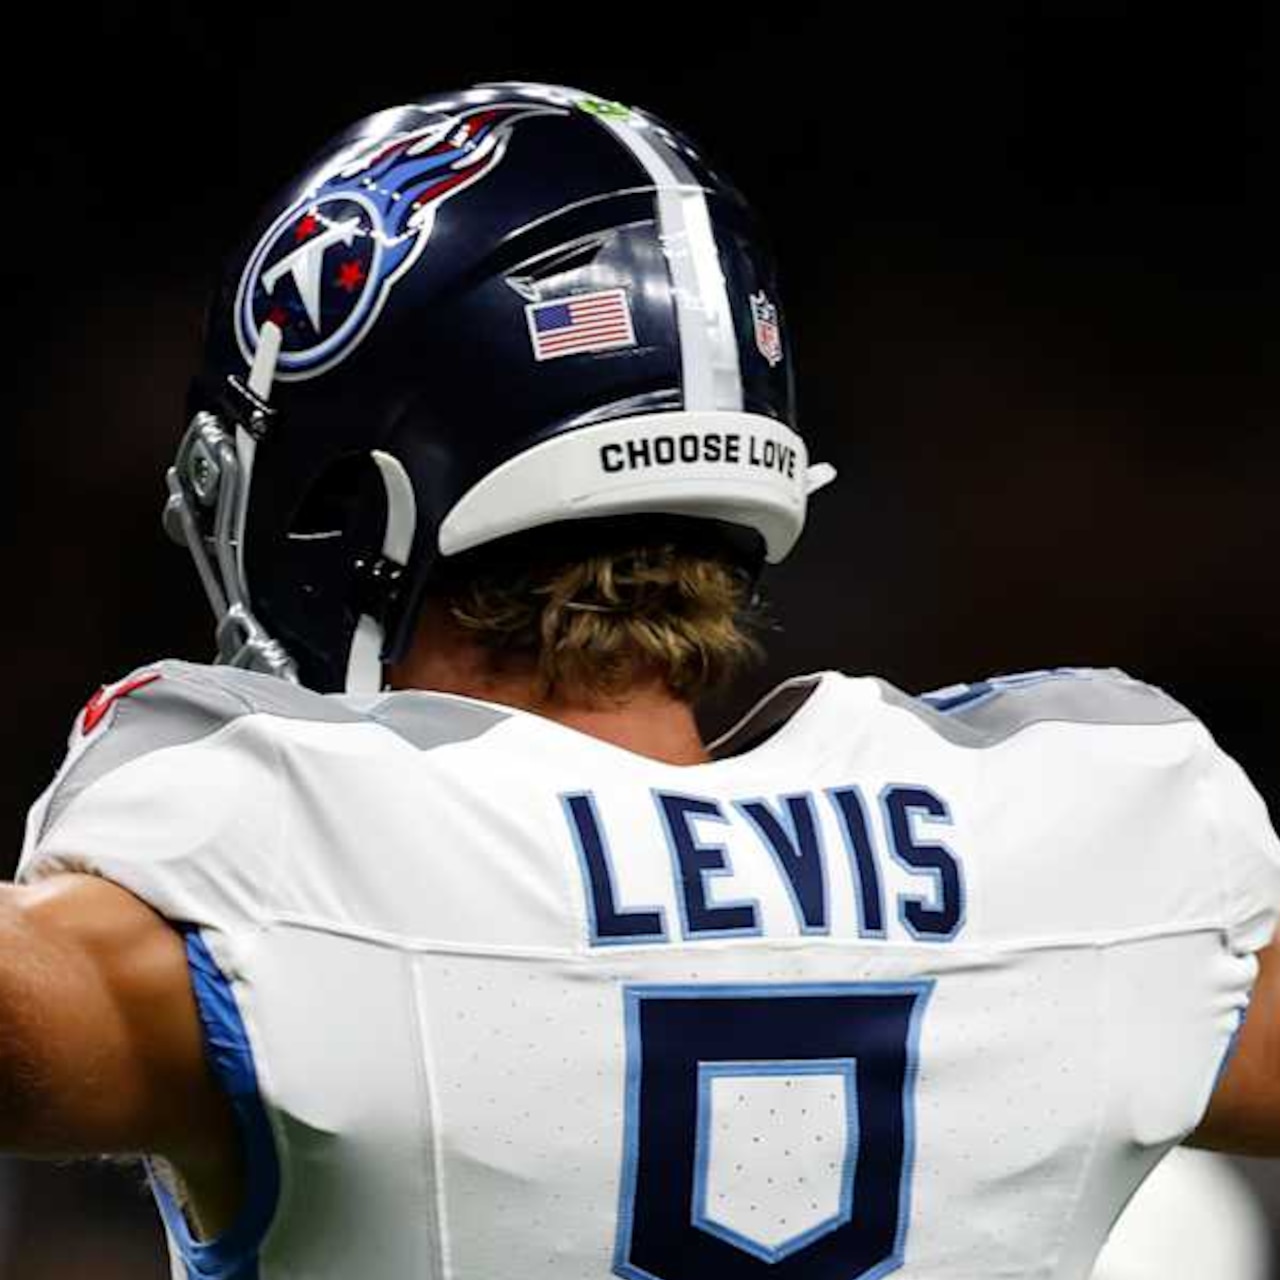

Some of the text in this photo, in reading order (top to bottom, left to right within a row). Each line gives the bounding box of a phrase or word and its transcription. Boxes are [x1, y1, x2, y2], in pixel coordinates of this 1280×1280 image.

[600, 434, 796, 479] CHOOSE LOVE
[558, 784, 966, 945] LEVIS
